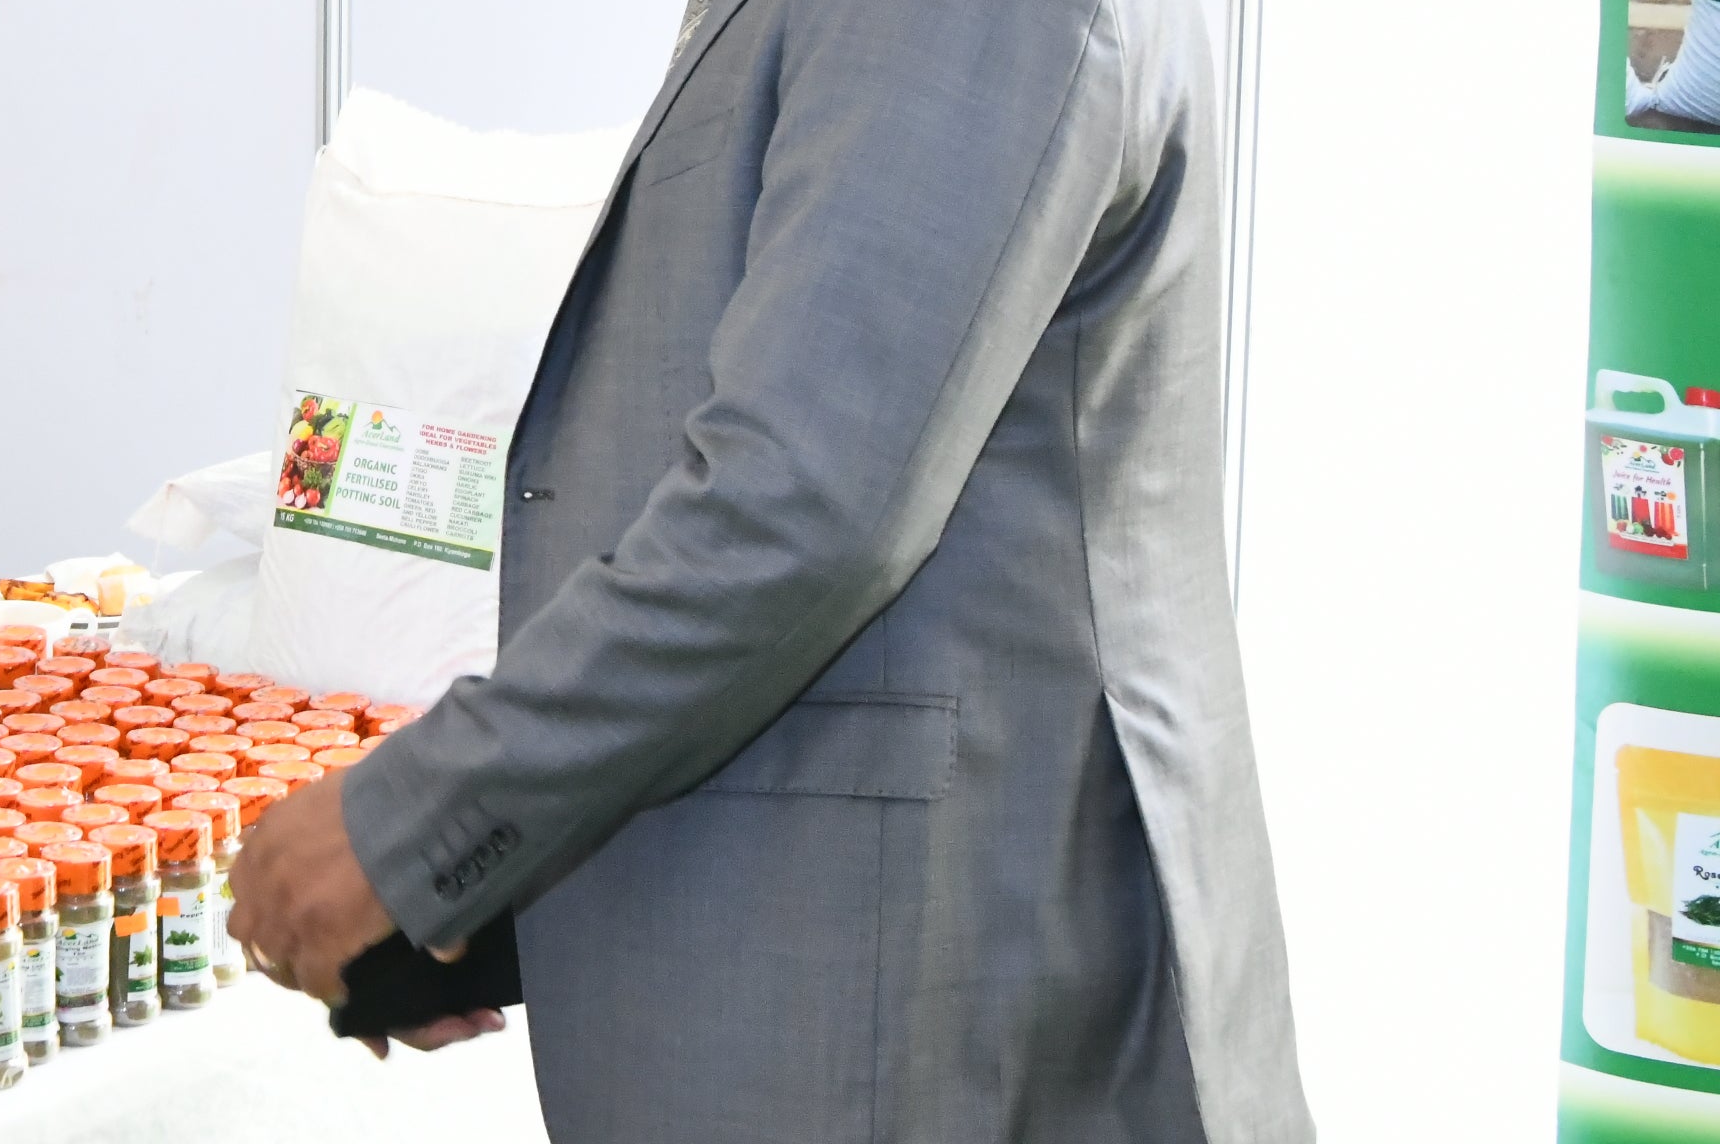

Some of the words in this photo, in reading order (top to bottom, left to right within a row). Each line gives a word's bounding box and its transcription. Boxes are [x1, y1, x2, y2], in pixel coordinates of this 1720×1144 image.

[420, 431, 437, 439] IDEAL
[454, 437, 497, 450] VEGETABLES
[437, 426, 456, 435] HOME
[457, 431, 497, 443] GARDENING
[455, 445, 487, 455] FLOWERS
[354, 457, 398, 475] ORGANIC
[345, 472, 398, 491] FERTILISED
[1646, 476, 1672, 486] Health
[336, 487, 377, 504] POTTING
[378, 496, 401, 509] SOIL
[285, 512, 295, 522] KG
